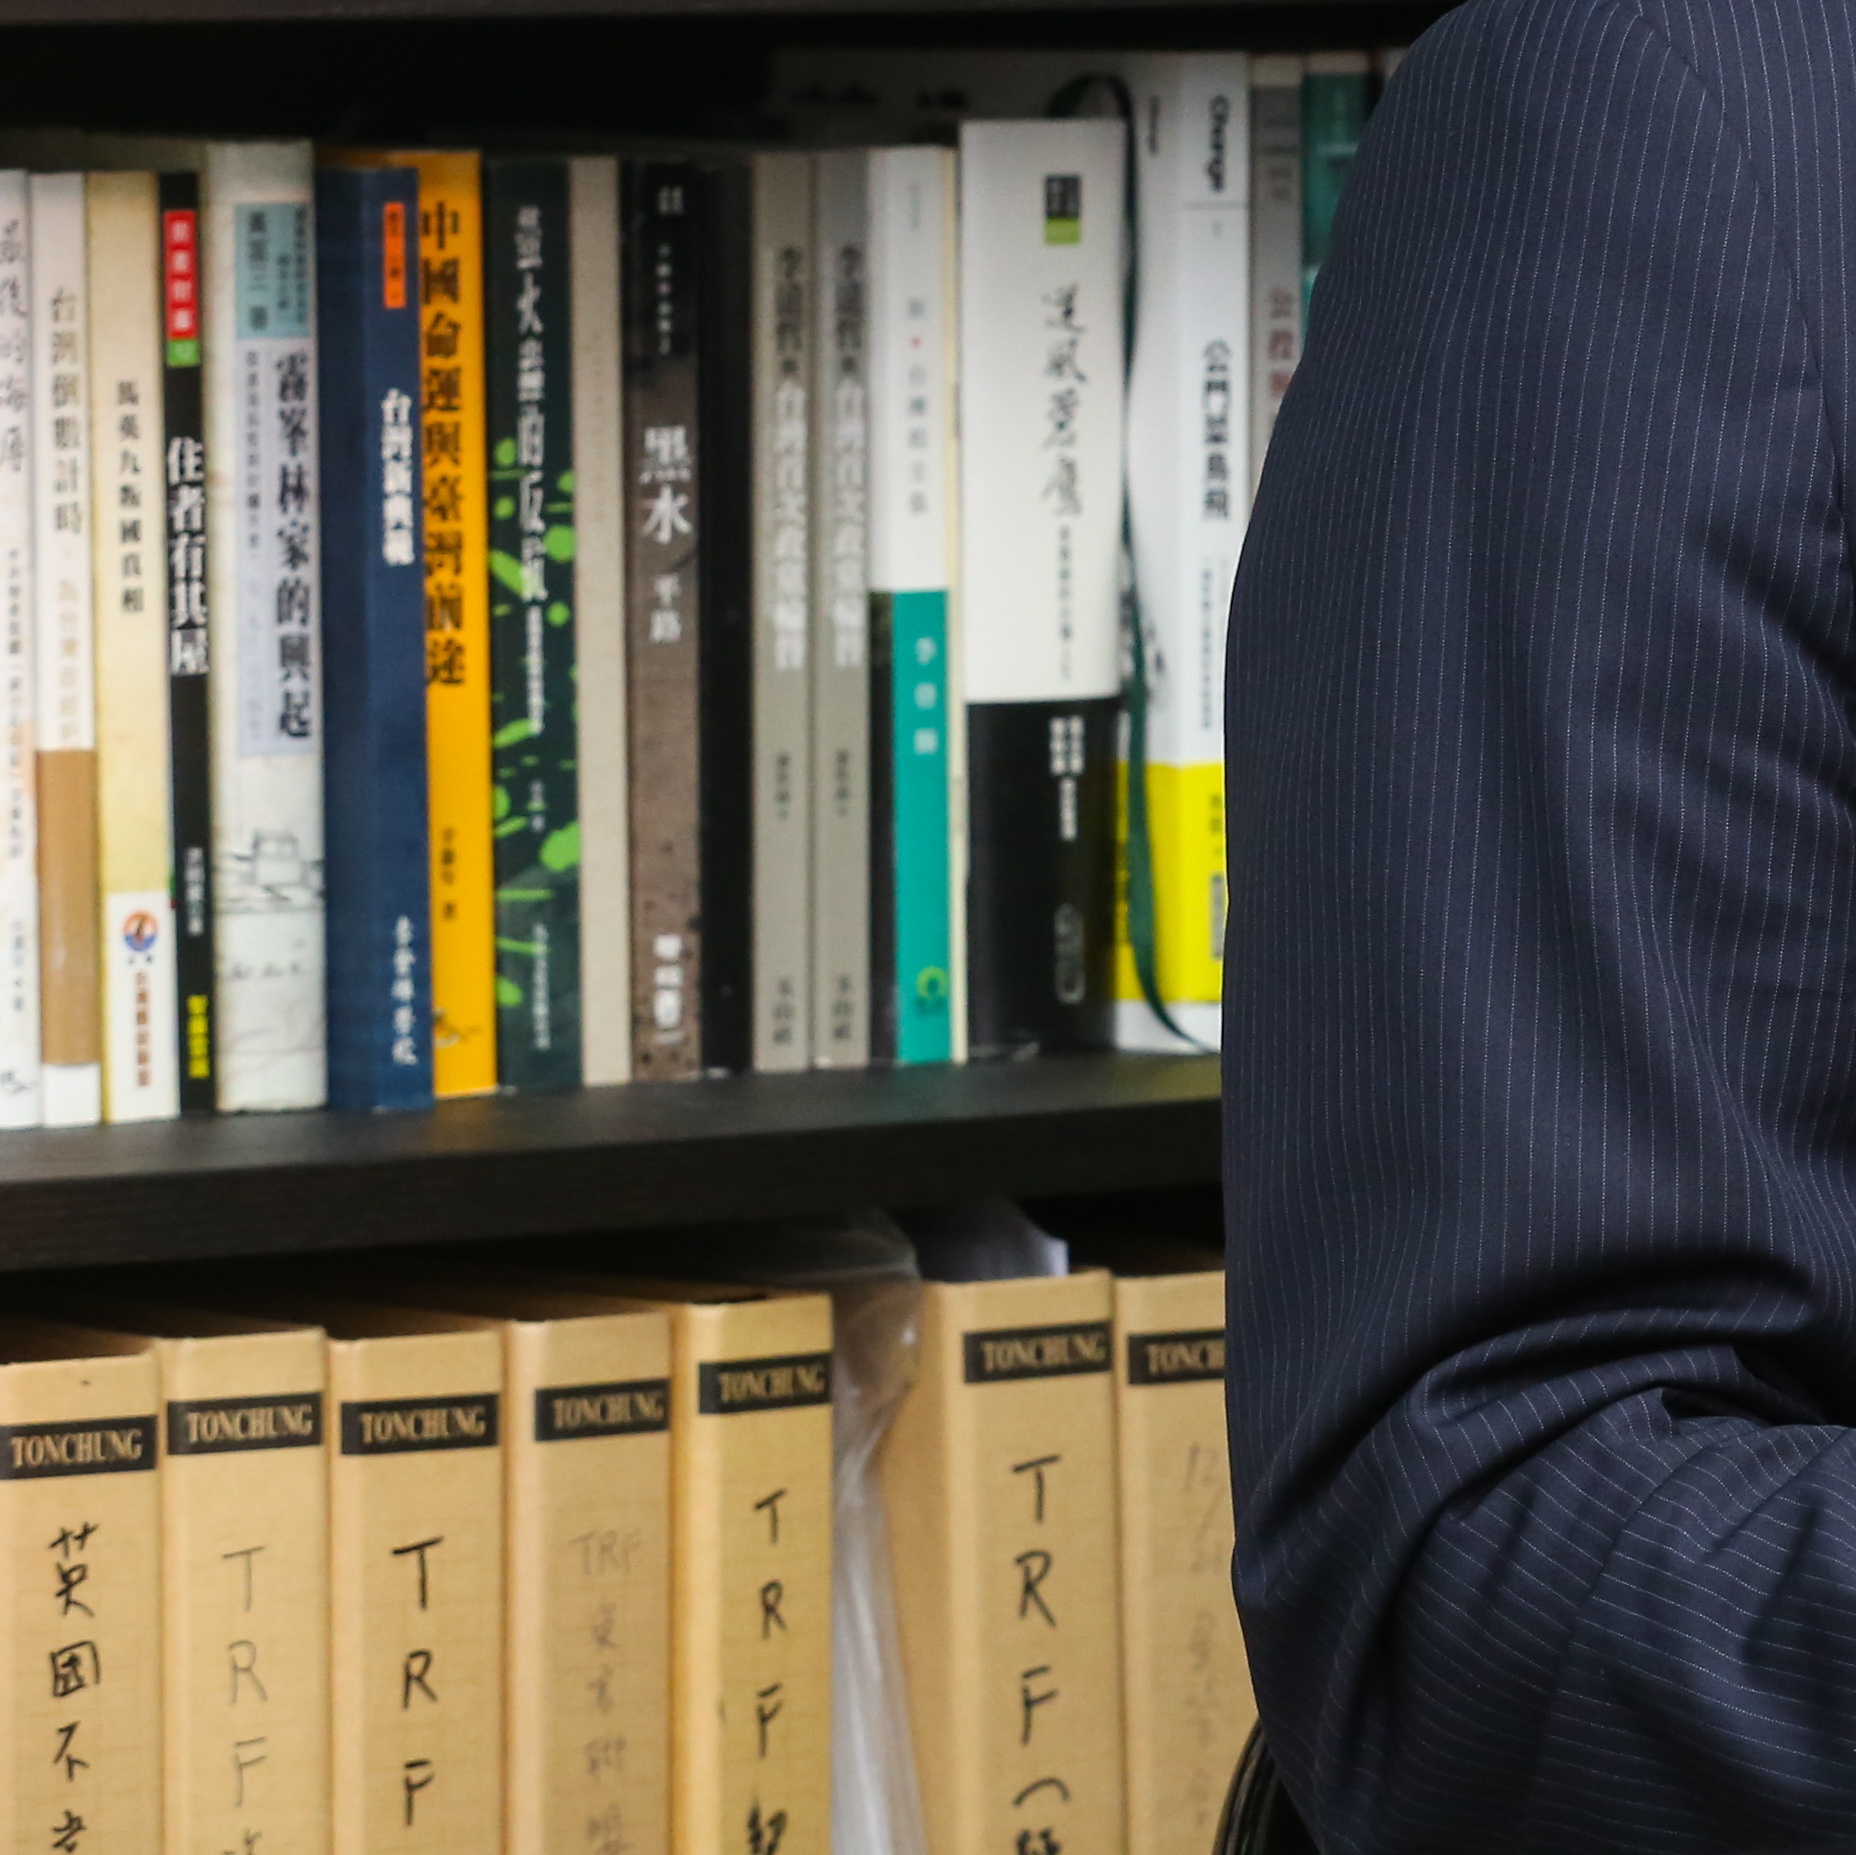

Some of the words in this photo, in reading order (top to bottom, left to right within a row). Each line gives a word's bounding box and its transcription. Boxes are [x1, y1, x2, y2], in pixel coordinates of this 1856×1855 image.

[641, 424, 694, 544] 黑水
[166, 436, 209, 676] 住者有其屋
[981, 1331, 1106, 1374] TONCHUNG
[1146, 1340, 1224, 1374] TONCH
[718, 1361, 825, 1405] TONCHUNG
[187, 1402, 314, 1443] TONCHUNG
[360, 1404, 488, 1444] TONCHUNG
[552, 1388, 666, 1430] TONCHUNG
[12, 1428, 144, 1471] TONCHUNG
[391, 1535, 445, 1828] TRF
